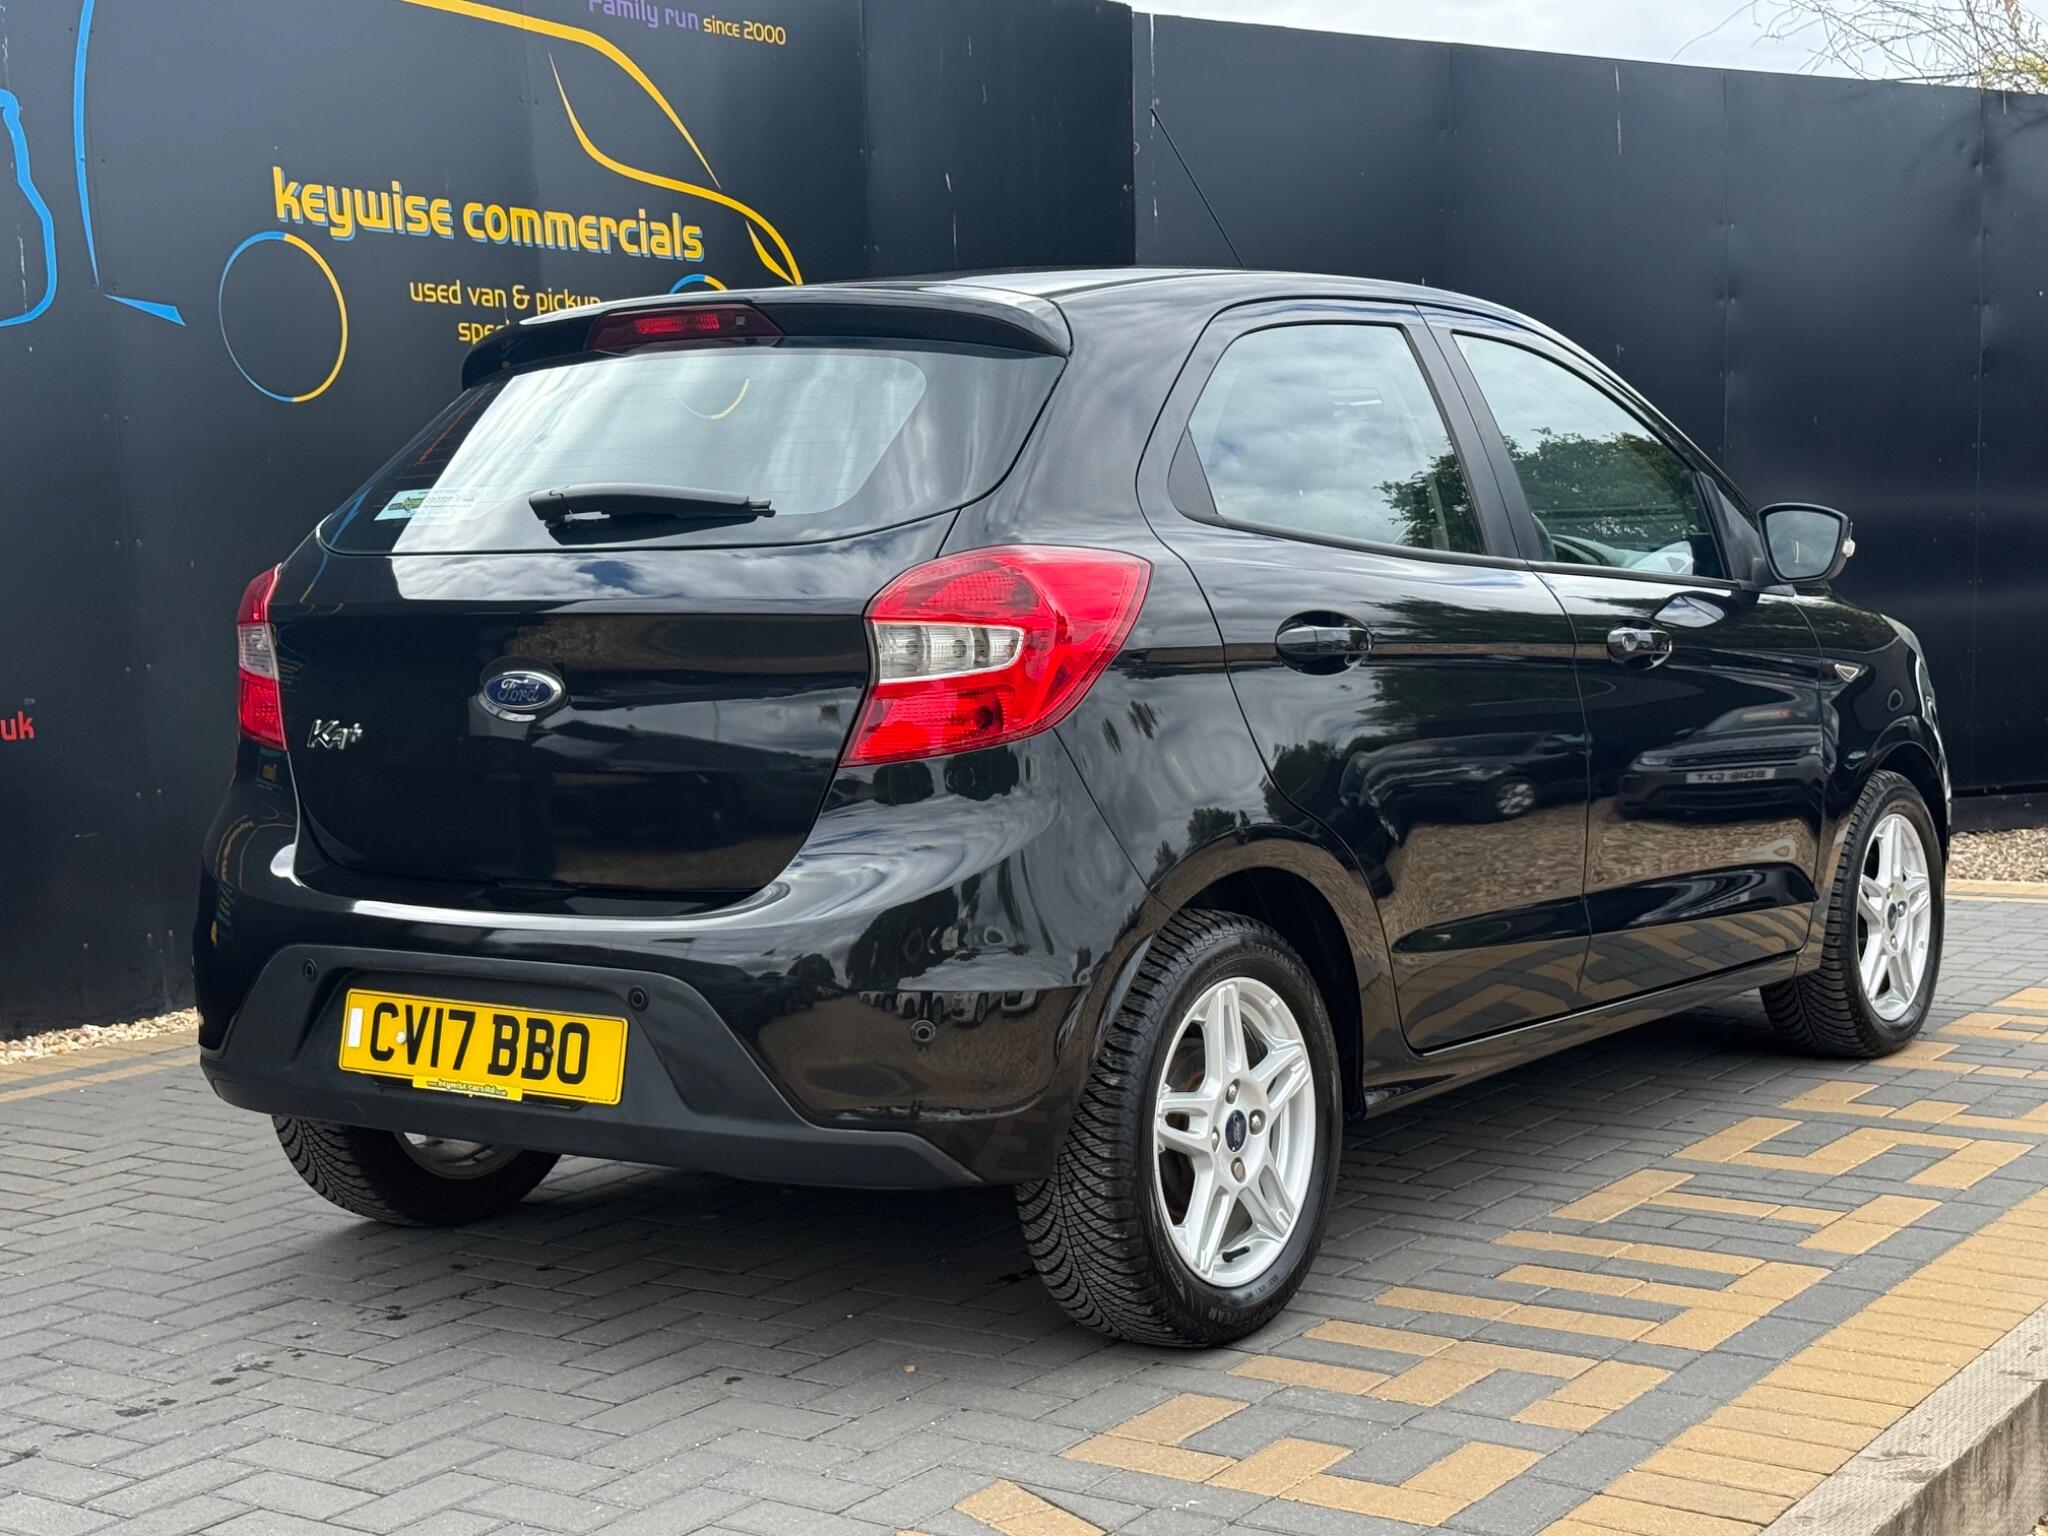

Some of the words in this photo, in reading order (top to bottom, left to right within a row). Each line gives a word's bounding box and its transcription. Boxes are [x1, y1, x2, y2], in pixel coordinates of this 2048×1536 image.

[665, 8, 699, 30] run
[703, 15, 741, 38] since
[743, 20, 786, 46] 2000
[272, 165, 455, 241] keywise
[462, 201, 705, 263] commercials
[409, 279, 462, 305] used
[467, 286, 508, 309] van
[512, 285, 530, 311] &
[498, 678, 539, 703] Ford
[369, 1001, 476, 1072] CV17
[487, 1014, 591, 1085] BBO
